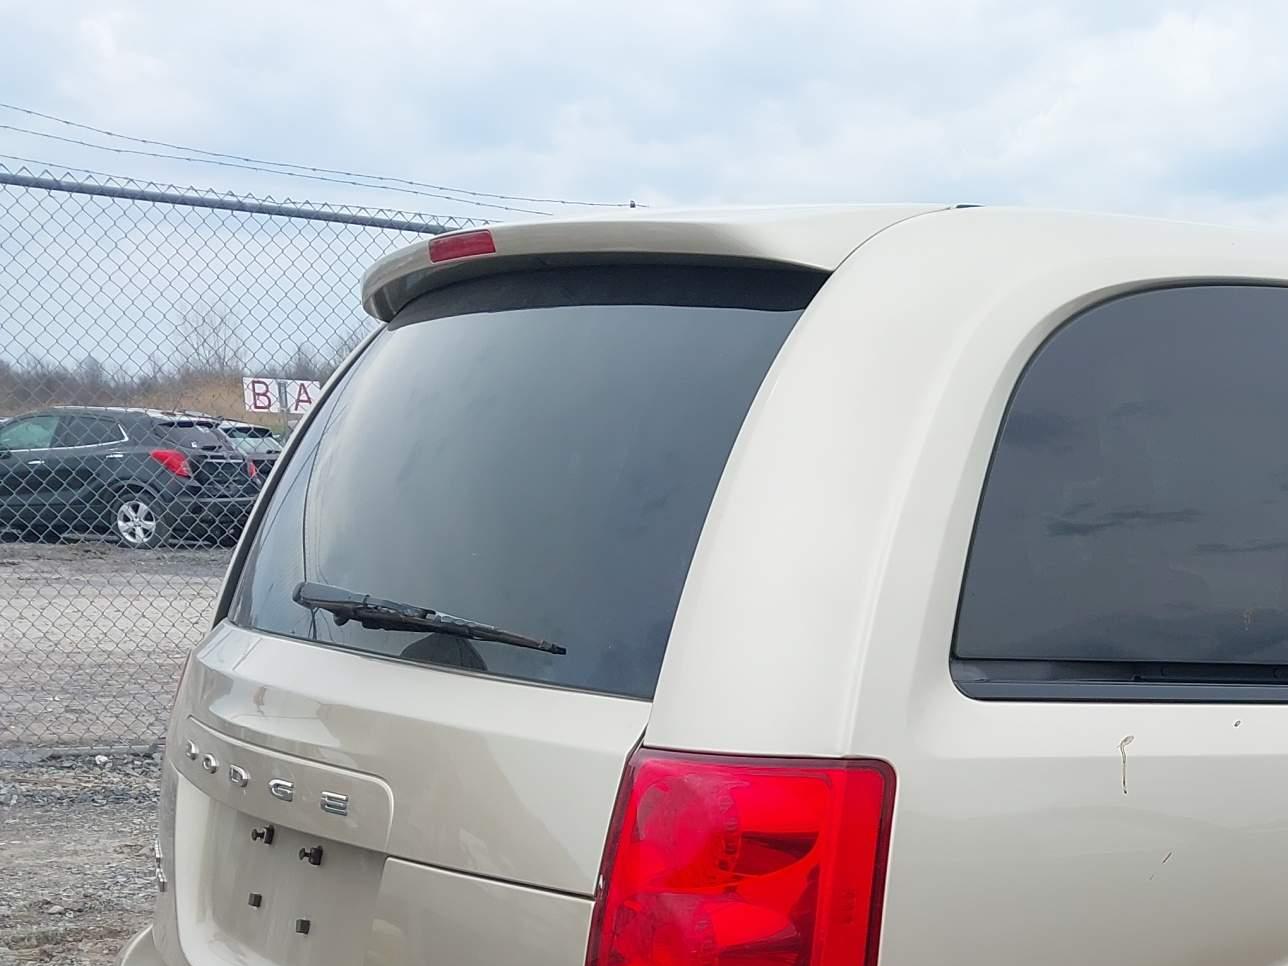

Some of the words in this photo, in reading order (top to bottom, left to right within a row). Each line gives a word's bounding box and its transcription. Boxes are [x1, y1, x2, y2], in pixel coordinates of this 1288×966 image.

[252, 380, 271, 409] B
[295, 383, 312, 411] A
[185, 739, 348, 817] DODGE
